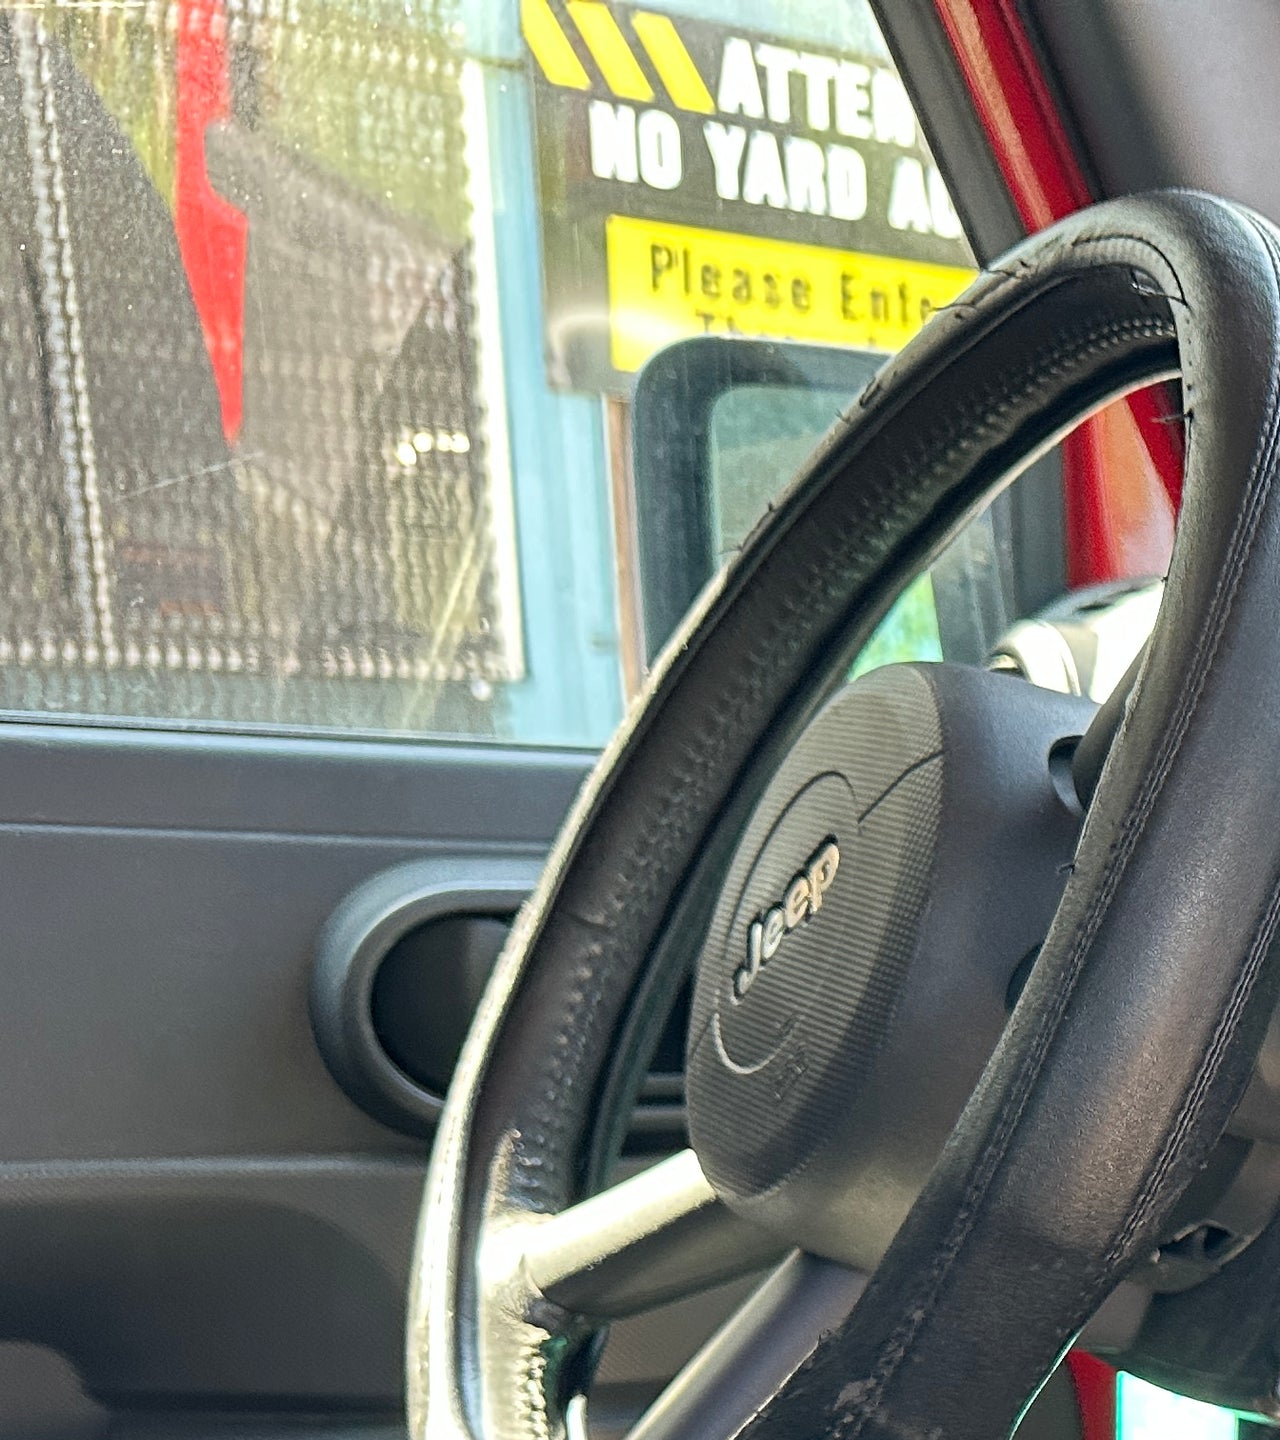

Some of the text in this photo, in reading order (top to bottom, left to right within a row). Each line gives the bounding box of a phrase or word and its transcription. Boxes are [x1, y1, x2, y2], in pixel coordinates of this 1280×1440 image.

[588, 99, 683, 191] NO
[702, 119, 868, 221] YARD
[650, 243, 811, 314] Please
[733, 840, 841, 996] Jeep
